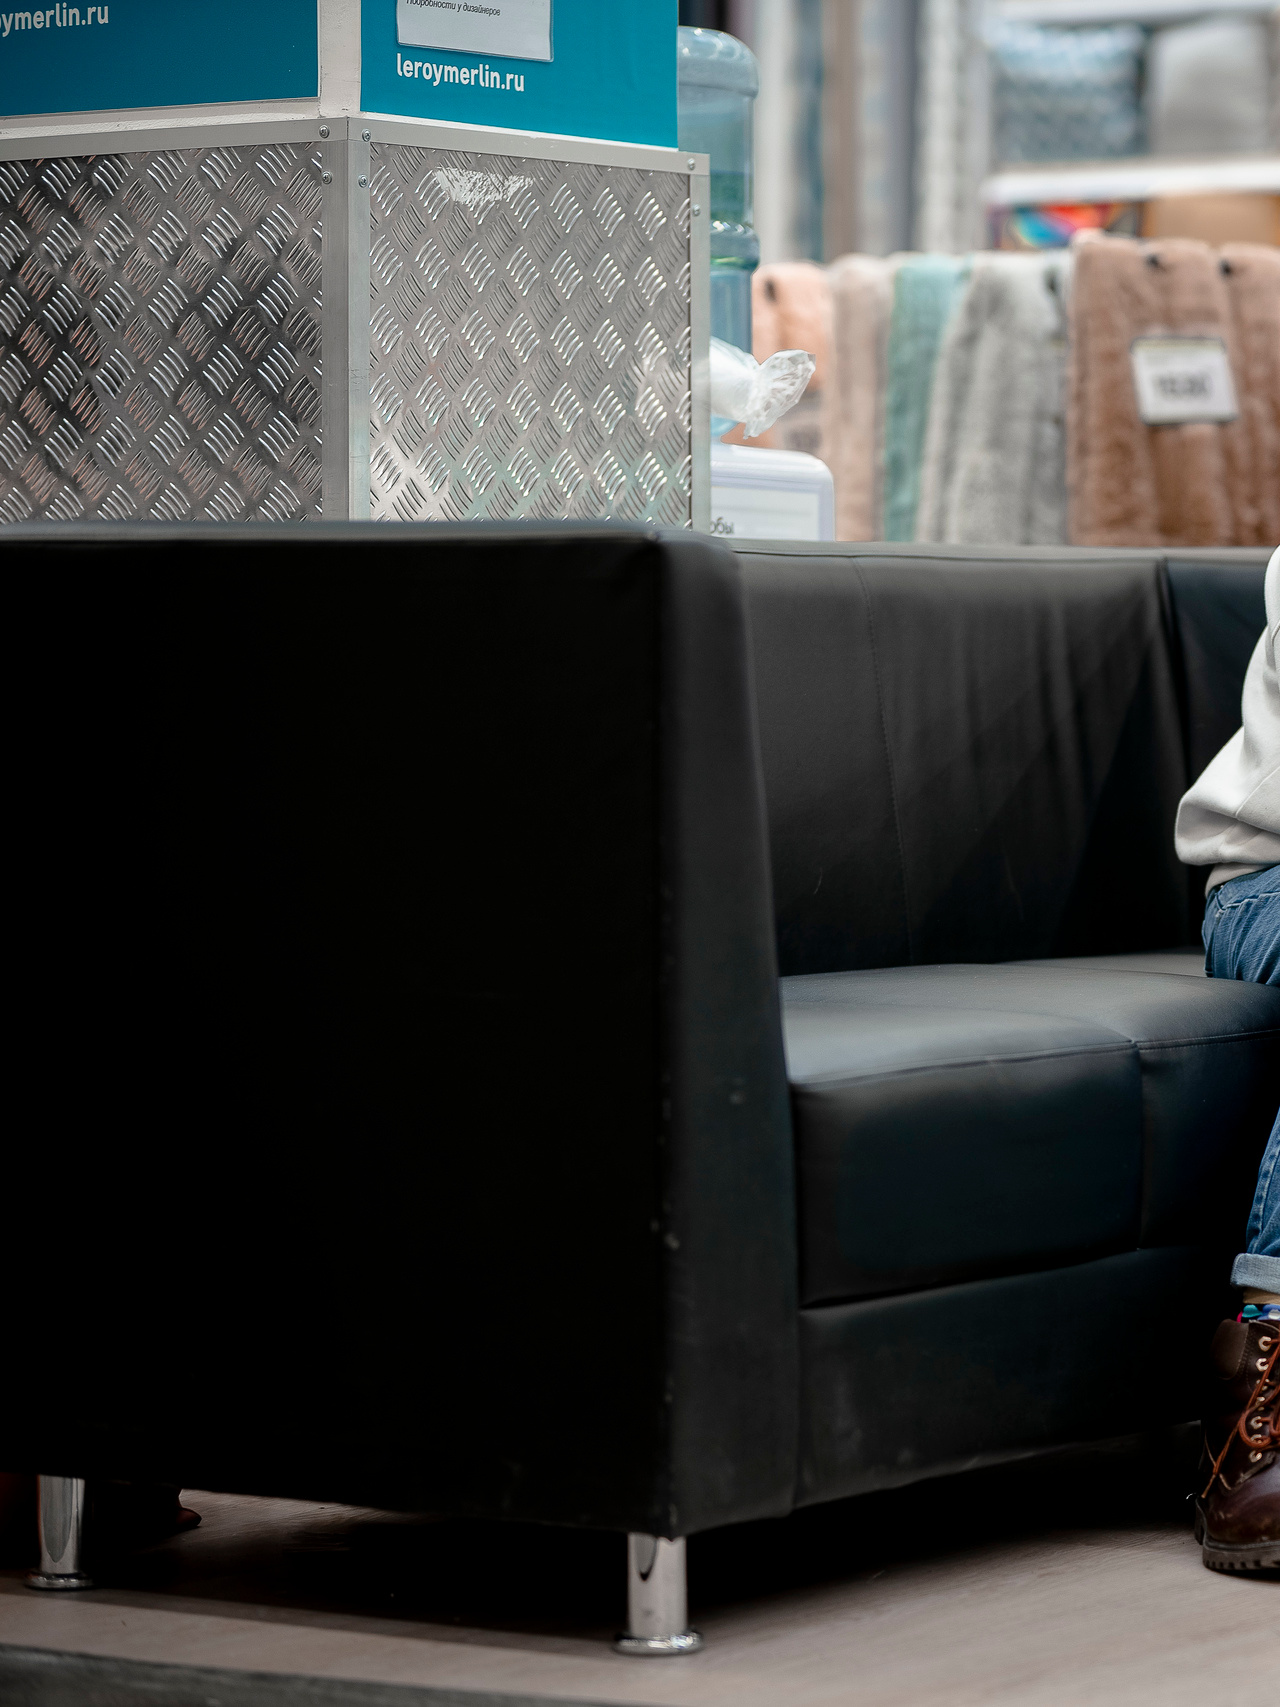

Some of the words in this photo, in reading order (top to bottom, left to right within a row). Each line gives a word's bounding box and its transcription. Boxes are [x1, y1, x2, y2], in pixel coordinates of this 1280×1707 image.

[0, 2, 109, 37] ymerlin.ru
[457, 4, 462, 12] у
[463, 2, 501, 17] дизайнеров
[396, 53, 525, 92] leroymerlin.ru
